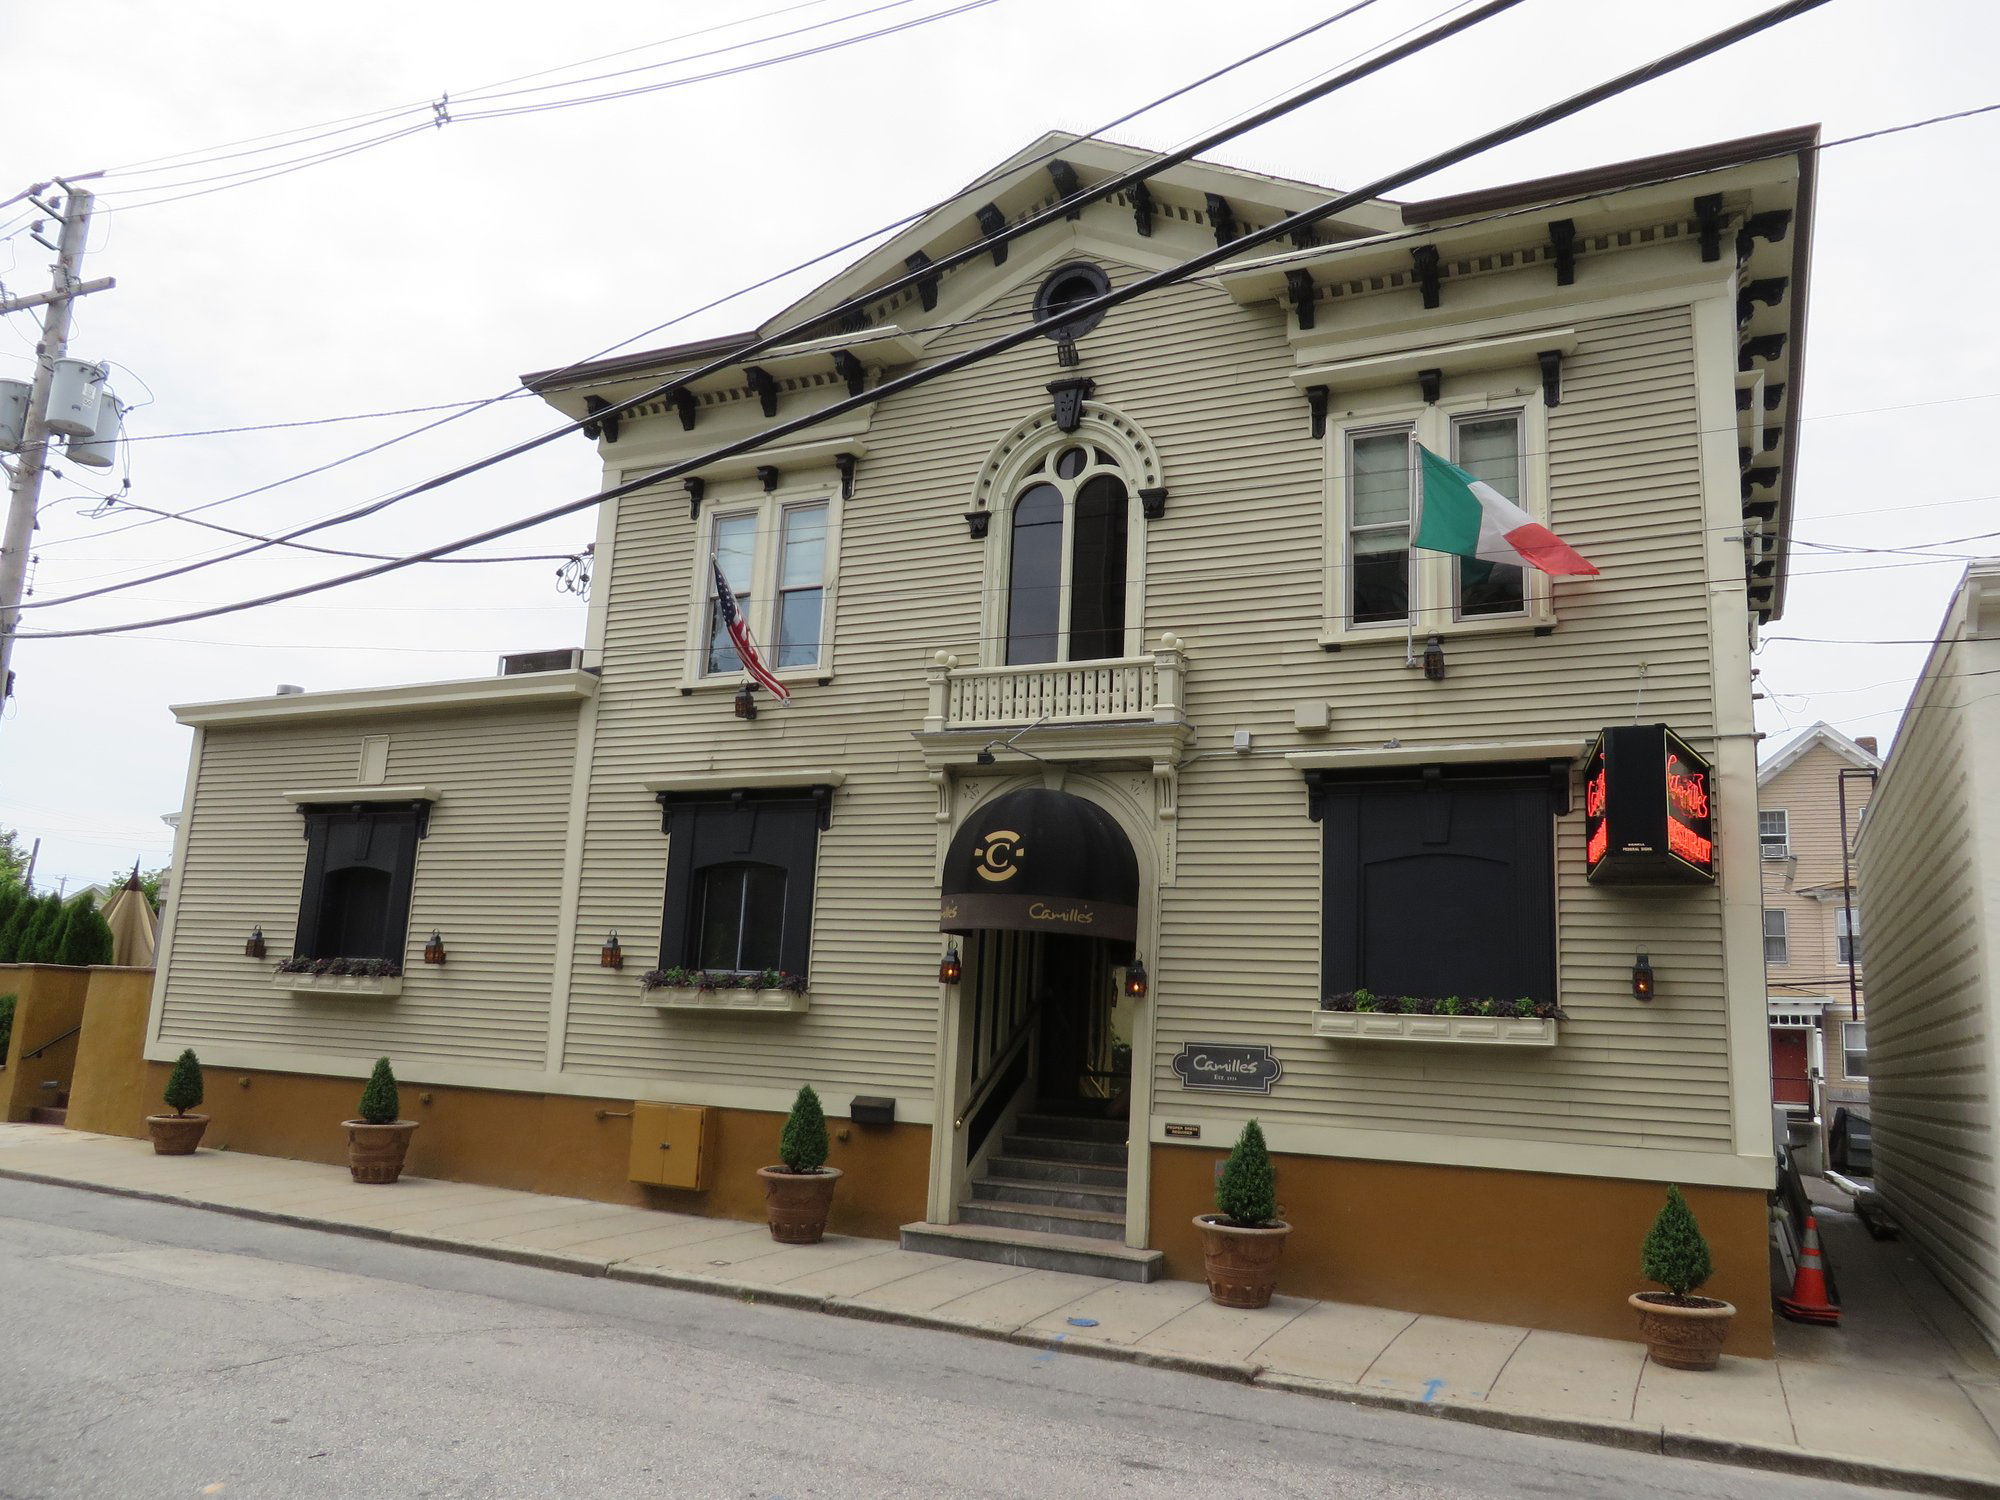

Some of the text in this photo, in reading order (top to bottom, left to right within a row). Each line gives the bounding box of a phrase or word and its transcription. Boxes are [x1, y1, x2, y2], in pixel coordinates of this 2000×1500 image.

[986, 842, 1011, 868] C
[1029, 902, 1094, 925] Camille's
[1193, 1054, 1258, 1074] Camille's
